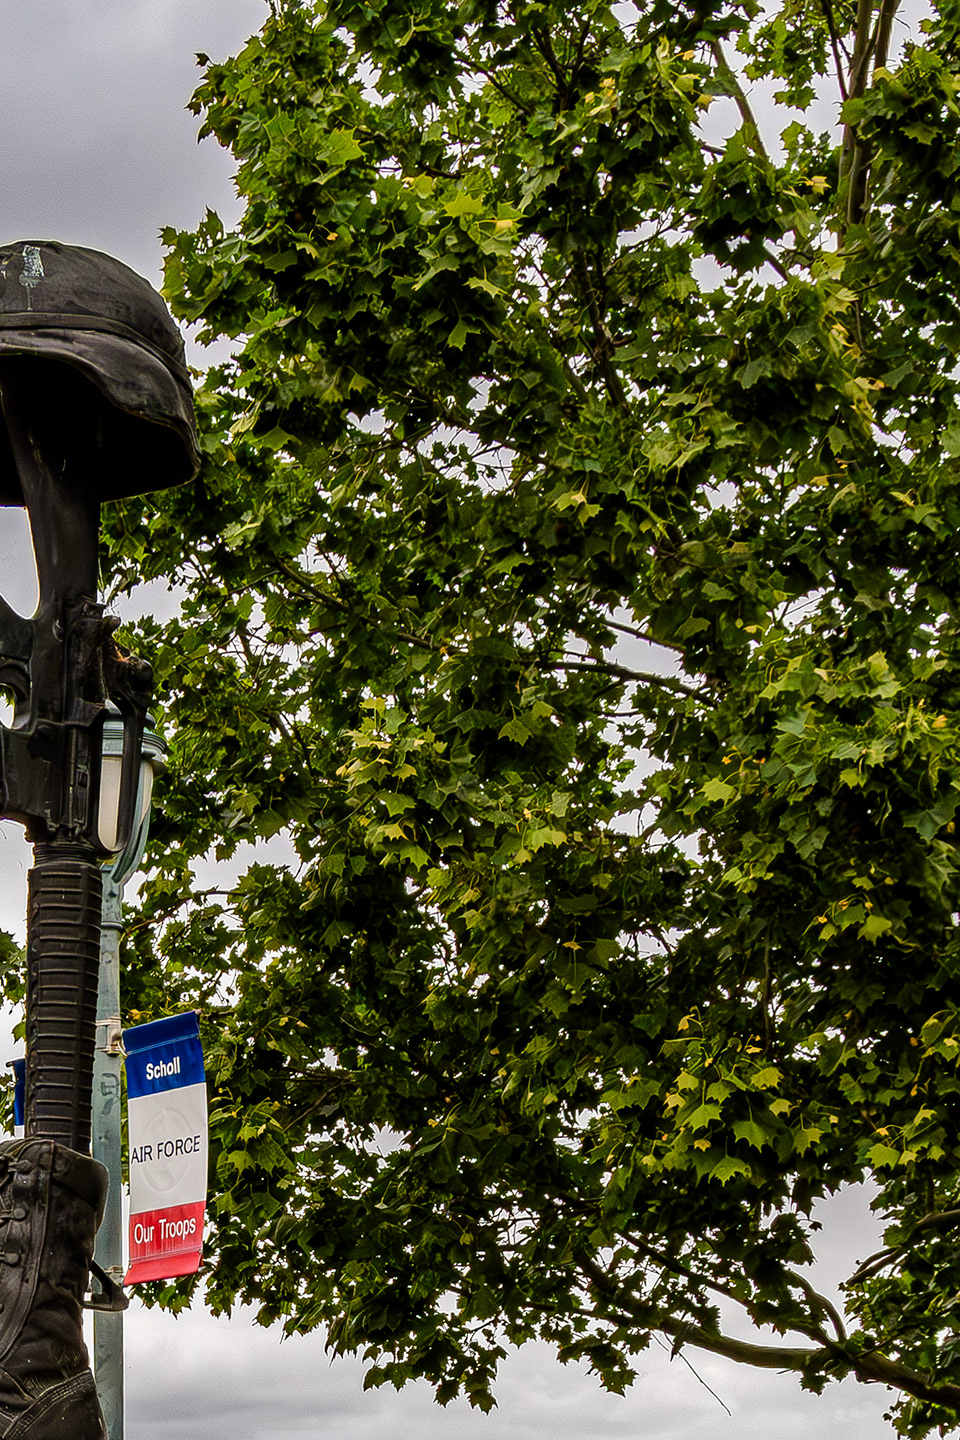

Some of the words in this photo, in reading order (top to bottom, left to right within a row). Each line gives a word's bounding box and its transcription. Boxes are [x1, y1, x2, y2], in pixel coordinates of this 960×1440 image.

[146, 1057, 181, 1081] Scholl
[131, 1143, 154, 1165] AIR
[157, 1135, 201, 1158] FORCE
[134, 1222, 155, 1245] Our
[158, 1217, 197, 1242] Troops
